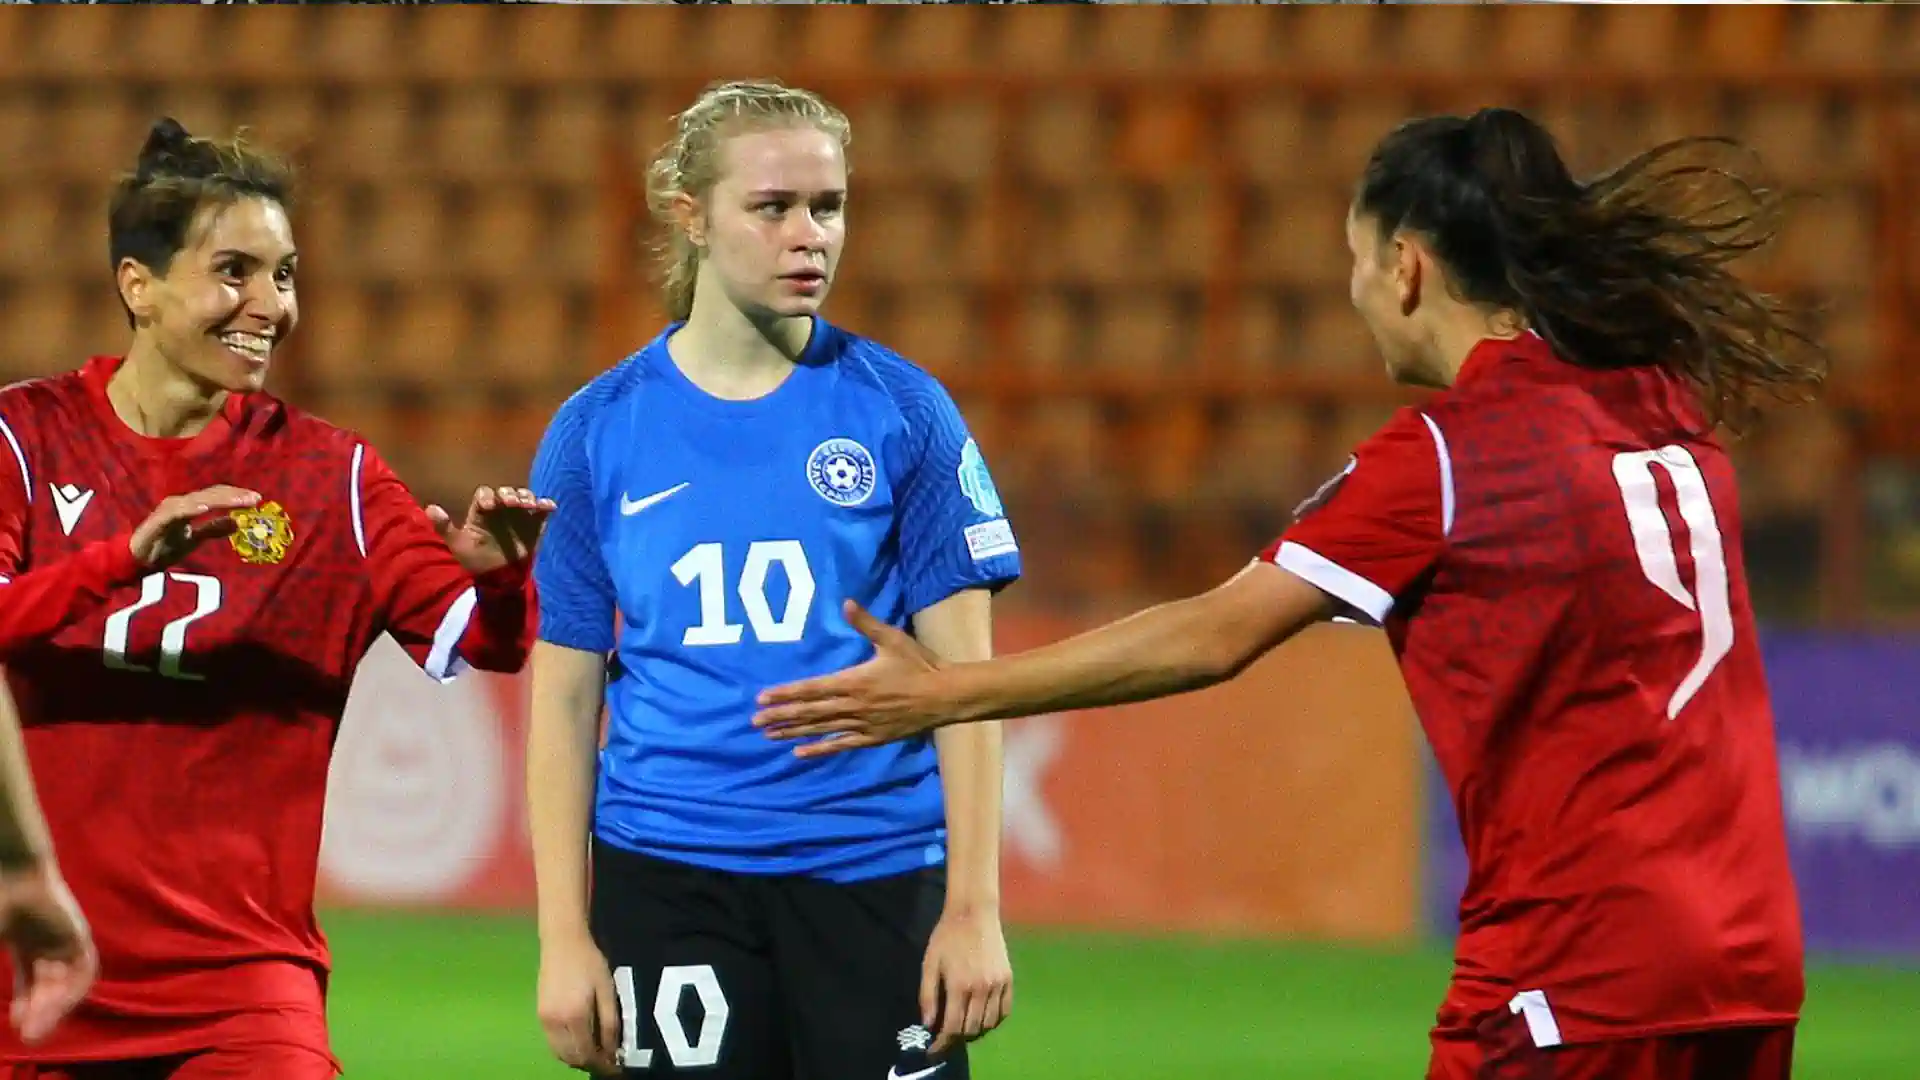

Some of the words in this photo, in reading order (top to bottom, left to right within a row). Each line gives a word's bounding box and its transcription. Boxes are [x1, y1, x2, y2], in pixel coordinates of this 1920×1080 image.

[105, 570, 221, 681] 22
[669, 540, 816, 646] 10
[614, 964, 730, 1068] 10
